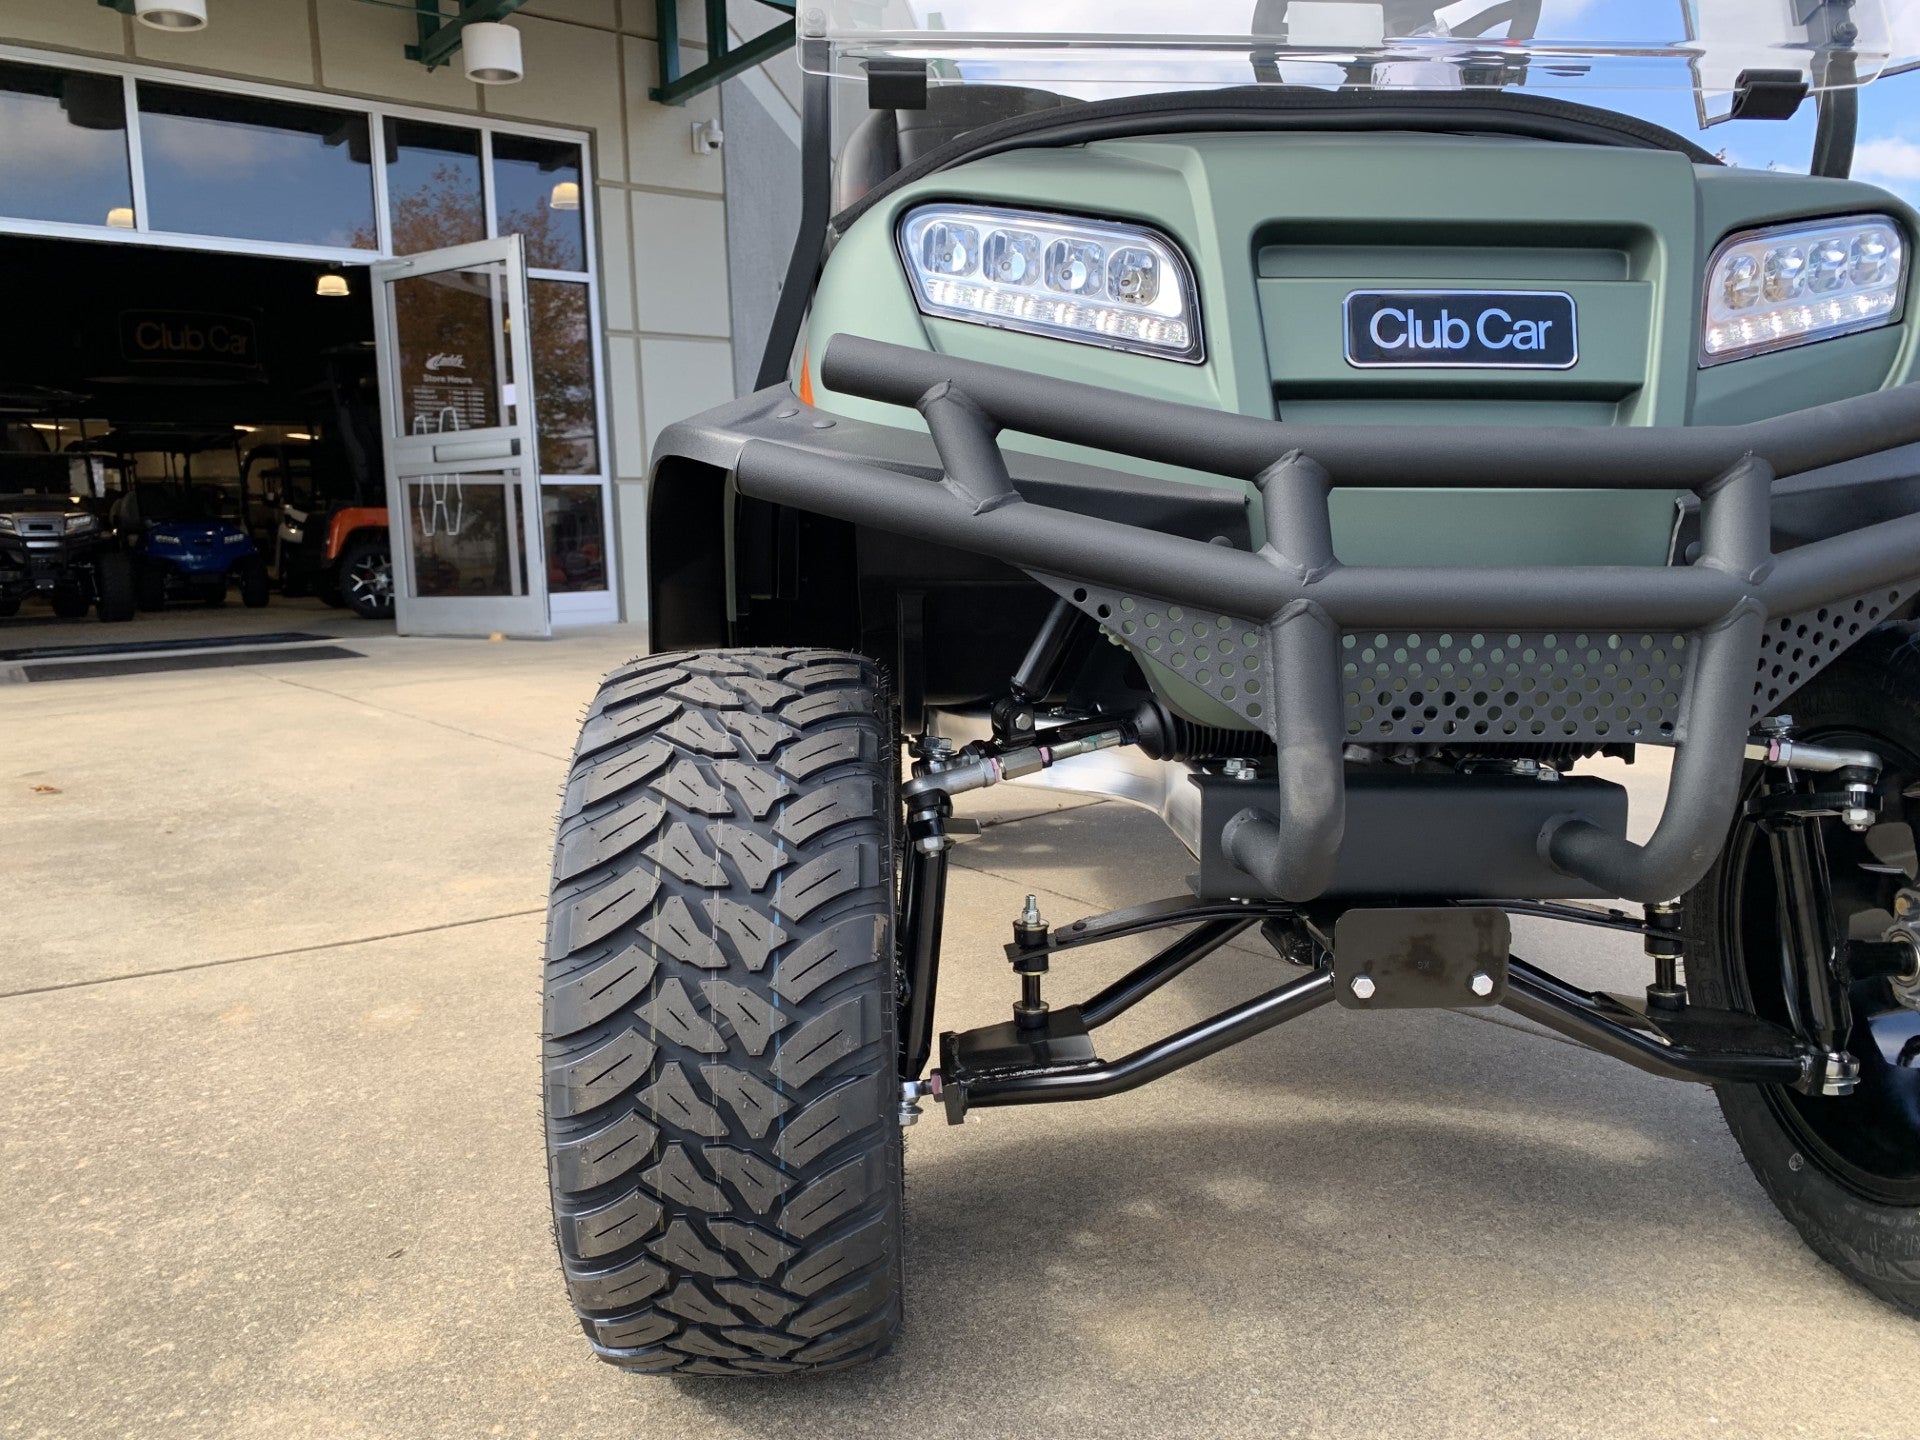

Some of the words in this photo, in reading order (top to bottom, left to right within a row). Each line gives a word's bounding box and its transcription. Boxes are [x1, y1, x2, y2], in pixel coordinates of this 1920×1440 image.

[135, 321, 205, 351] Club
[208, 324, 248, 355] Car
[1369, 307, 1470, 349] Club
[1476, 308, 1552, 350] Car
